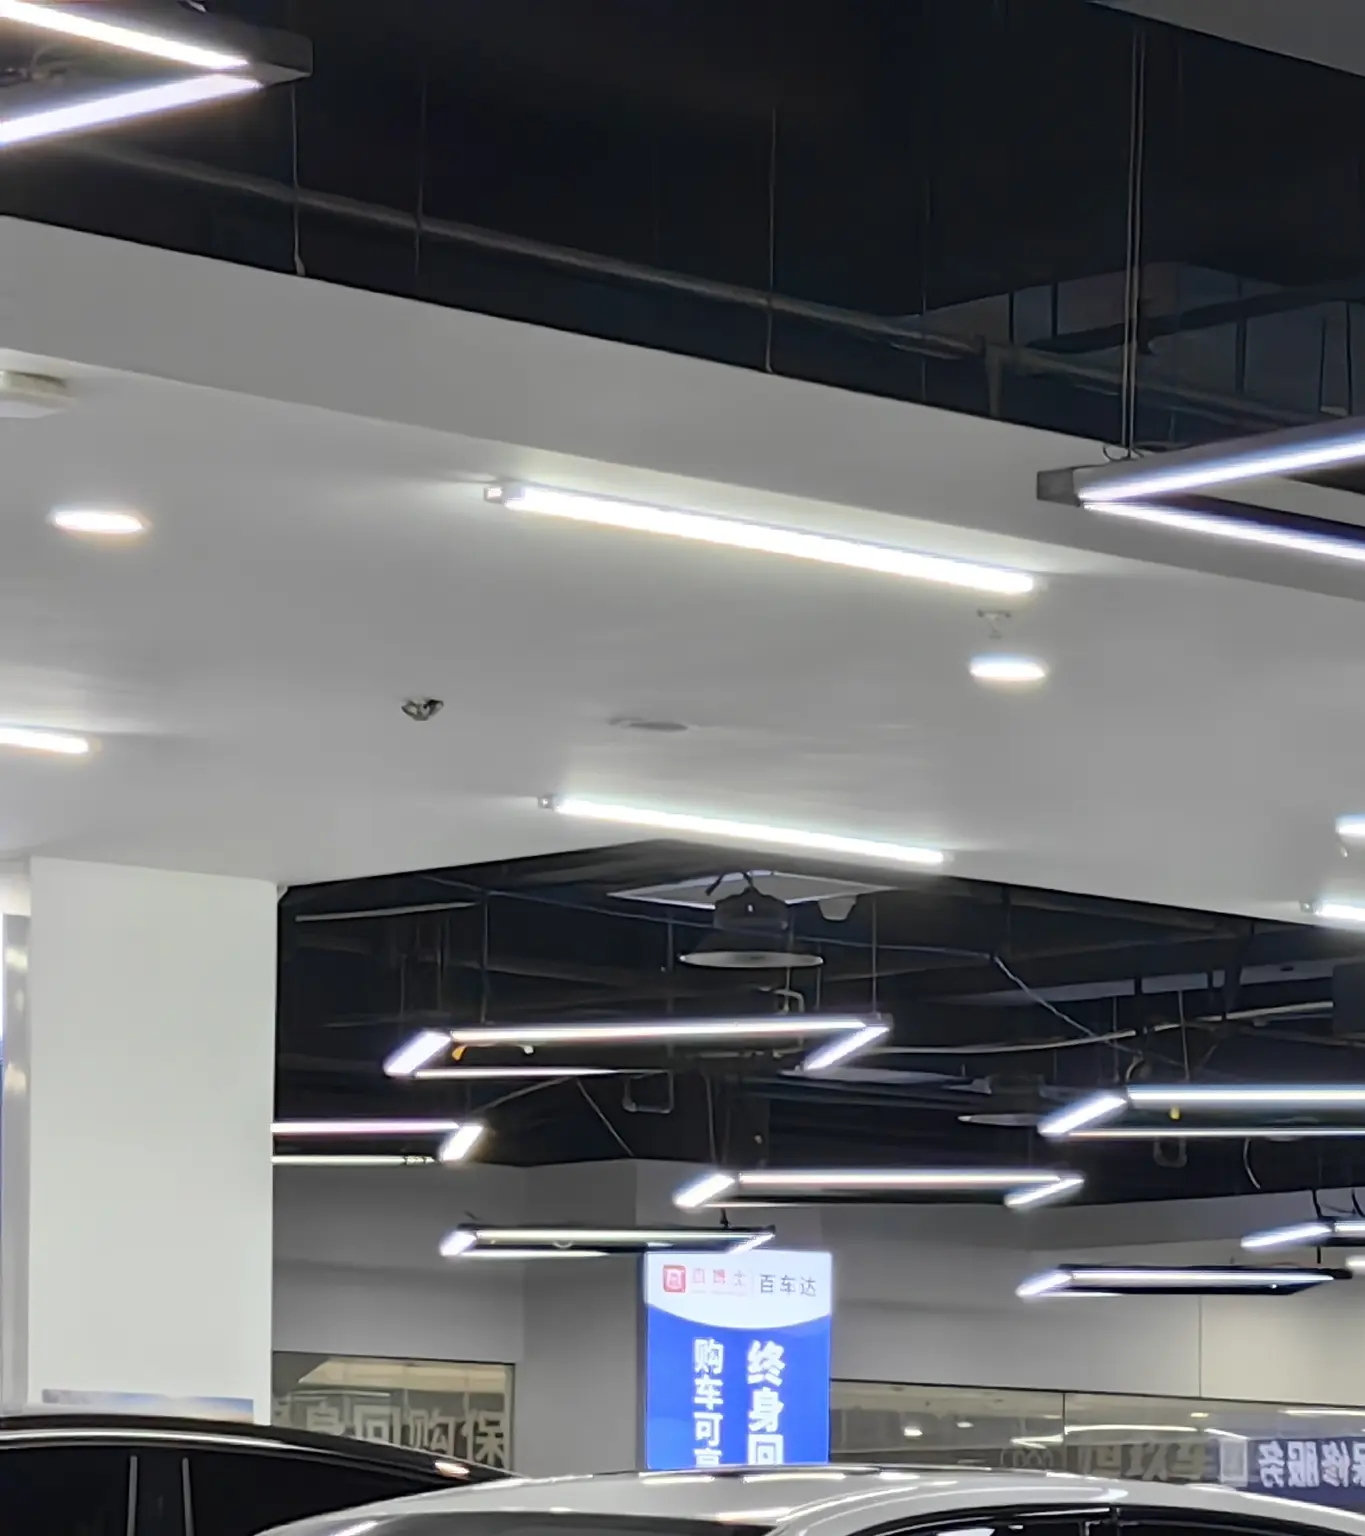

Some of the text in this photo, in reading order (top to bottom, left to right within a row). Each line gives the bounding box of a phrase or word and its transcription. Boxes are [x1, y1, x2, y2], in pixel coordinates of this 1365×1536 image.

[759, 1273, 817, 1298] 百车达
[747, 1340, 785, 1464] 终身回
